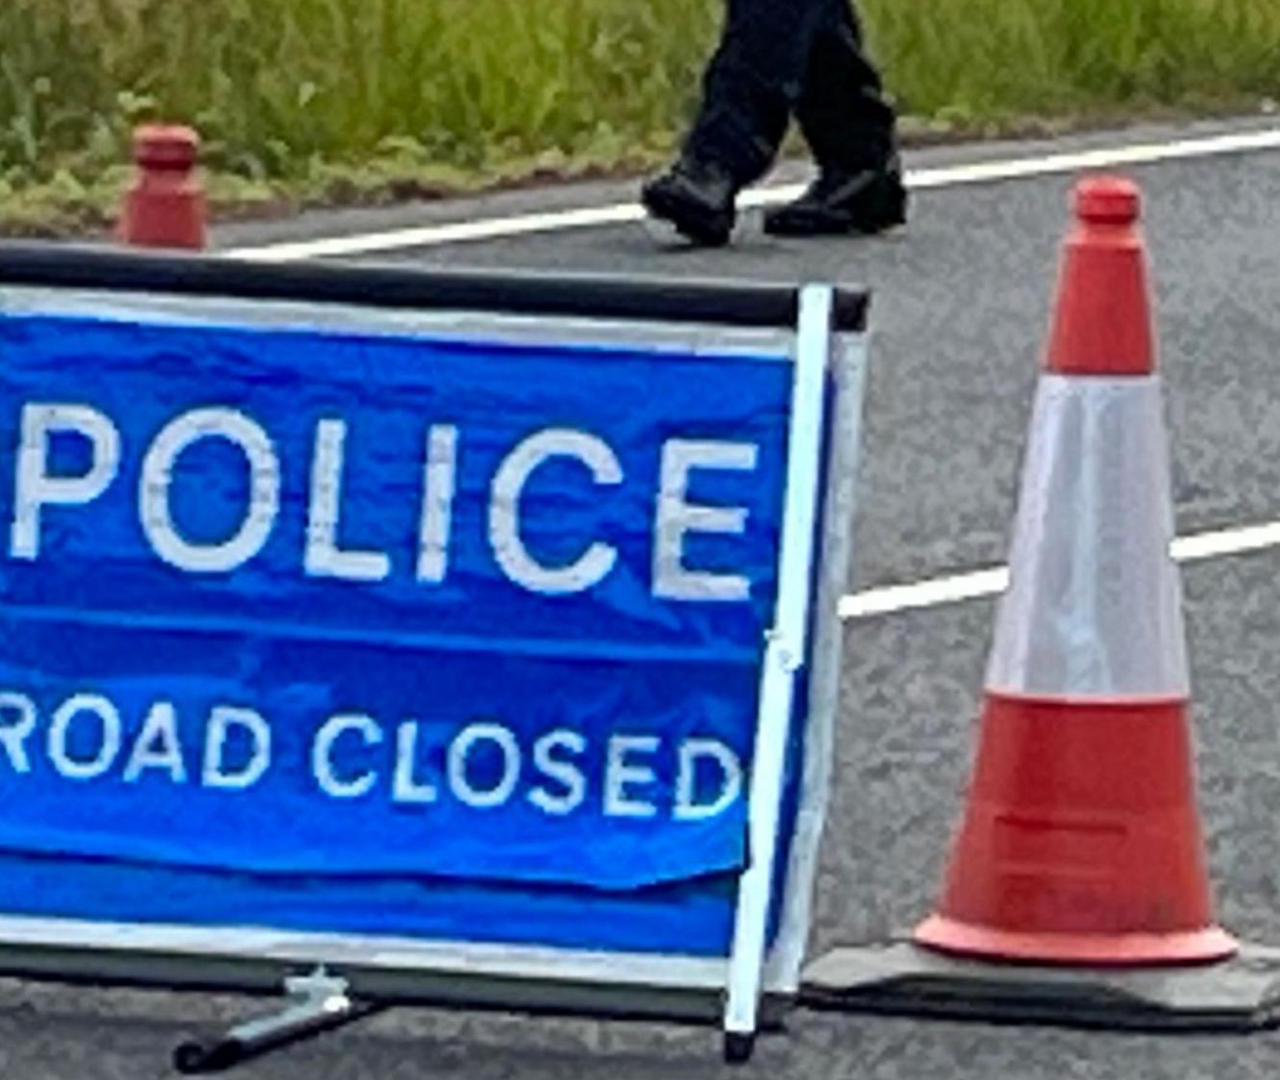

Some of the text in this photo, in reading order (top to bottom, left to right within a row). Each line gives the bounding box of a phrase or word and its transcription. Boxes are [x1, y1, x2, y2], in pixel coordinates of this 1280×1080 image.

[9, 402, 760, 601] POLICE
[0, 690, 745, 822] ROAD CLOSED
